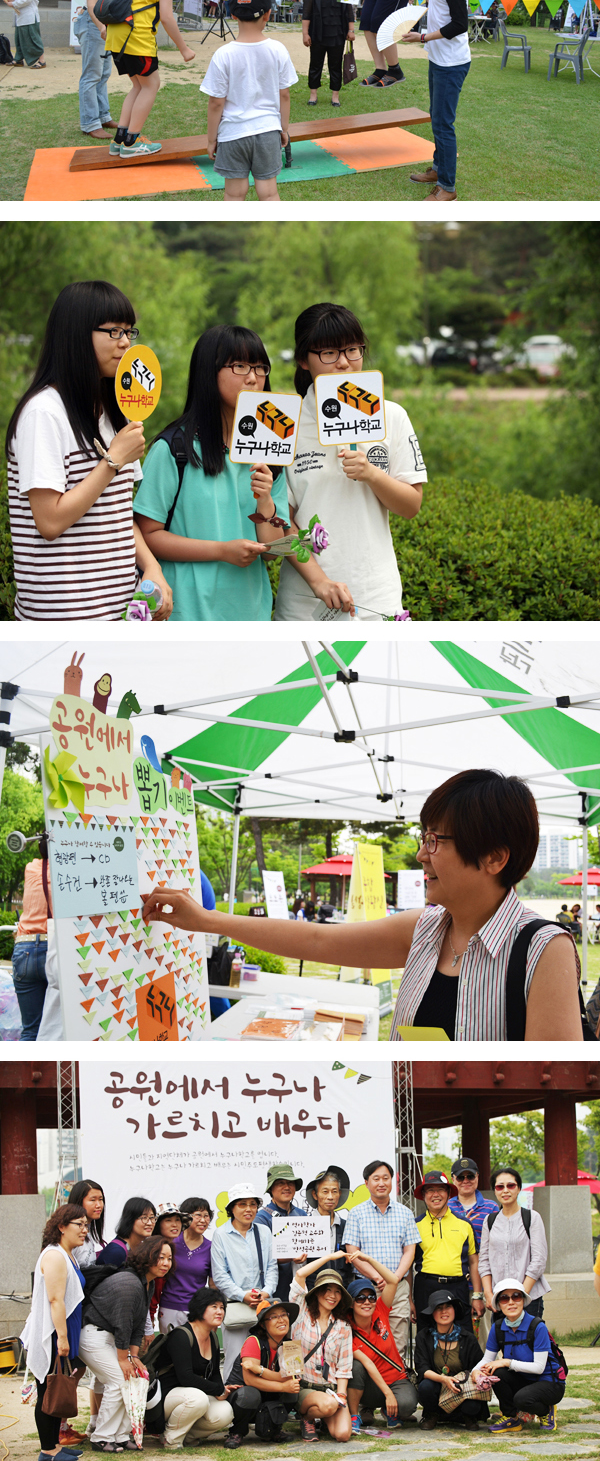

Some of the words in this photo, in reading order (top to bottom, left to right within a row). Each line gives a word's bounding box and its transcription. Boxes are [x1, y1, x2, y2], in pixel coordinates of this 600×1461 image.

[120, 393, 154, 408] 누구나학교
[325, 404, 338, 412] 수원
[241, 422, 254, 430] 수원
[323, 419, 382, 437] 누구나학교
[235, 439, 291, 457] 누구나학교
[52, 700, 131, 754] 공원에서
[78, 764, 129, 800] 누구나
[135, 762, 168, 812] 뽑기
[168, 791, 194, 816] 이벤트
[54, 849, 76, 866] 형광펜
[98, 853, 111, 864] CD
[57, 872, 82, 892] 손수건
[104, 1070, 229, 1108] 공원에서
[241, 1072, 326, 1103] 누구나
[126, 1110, 247, 1140] 가르치고
[257, 1109, 350, 1139] 배우다
